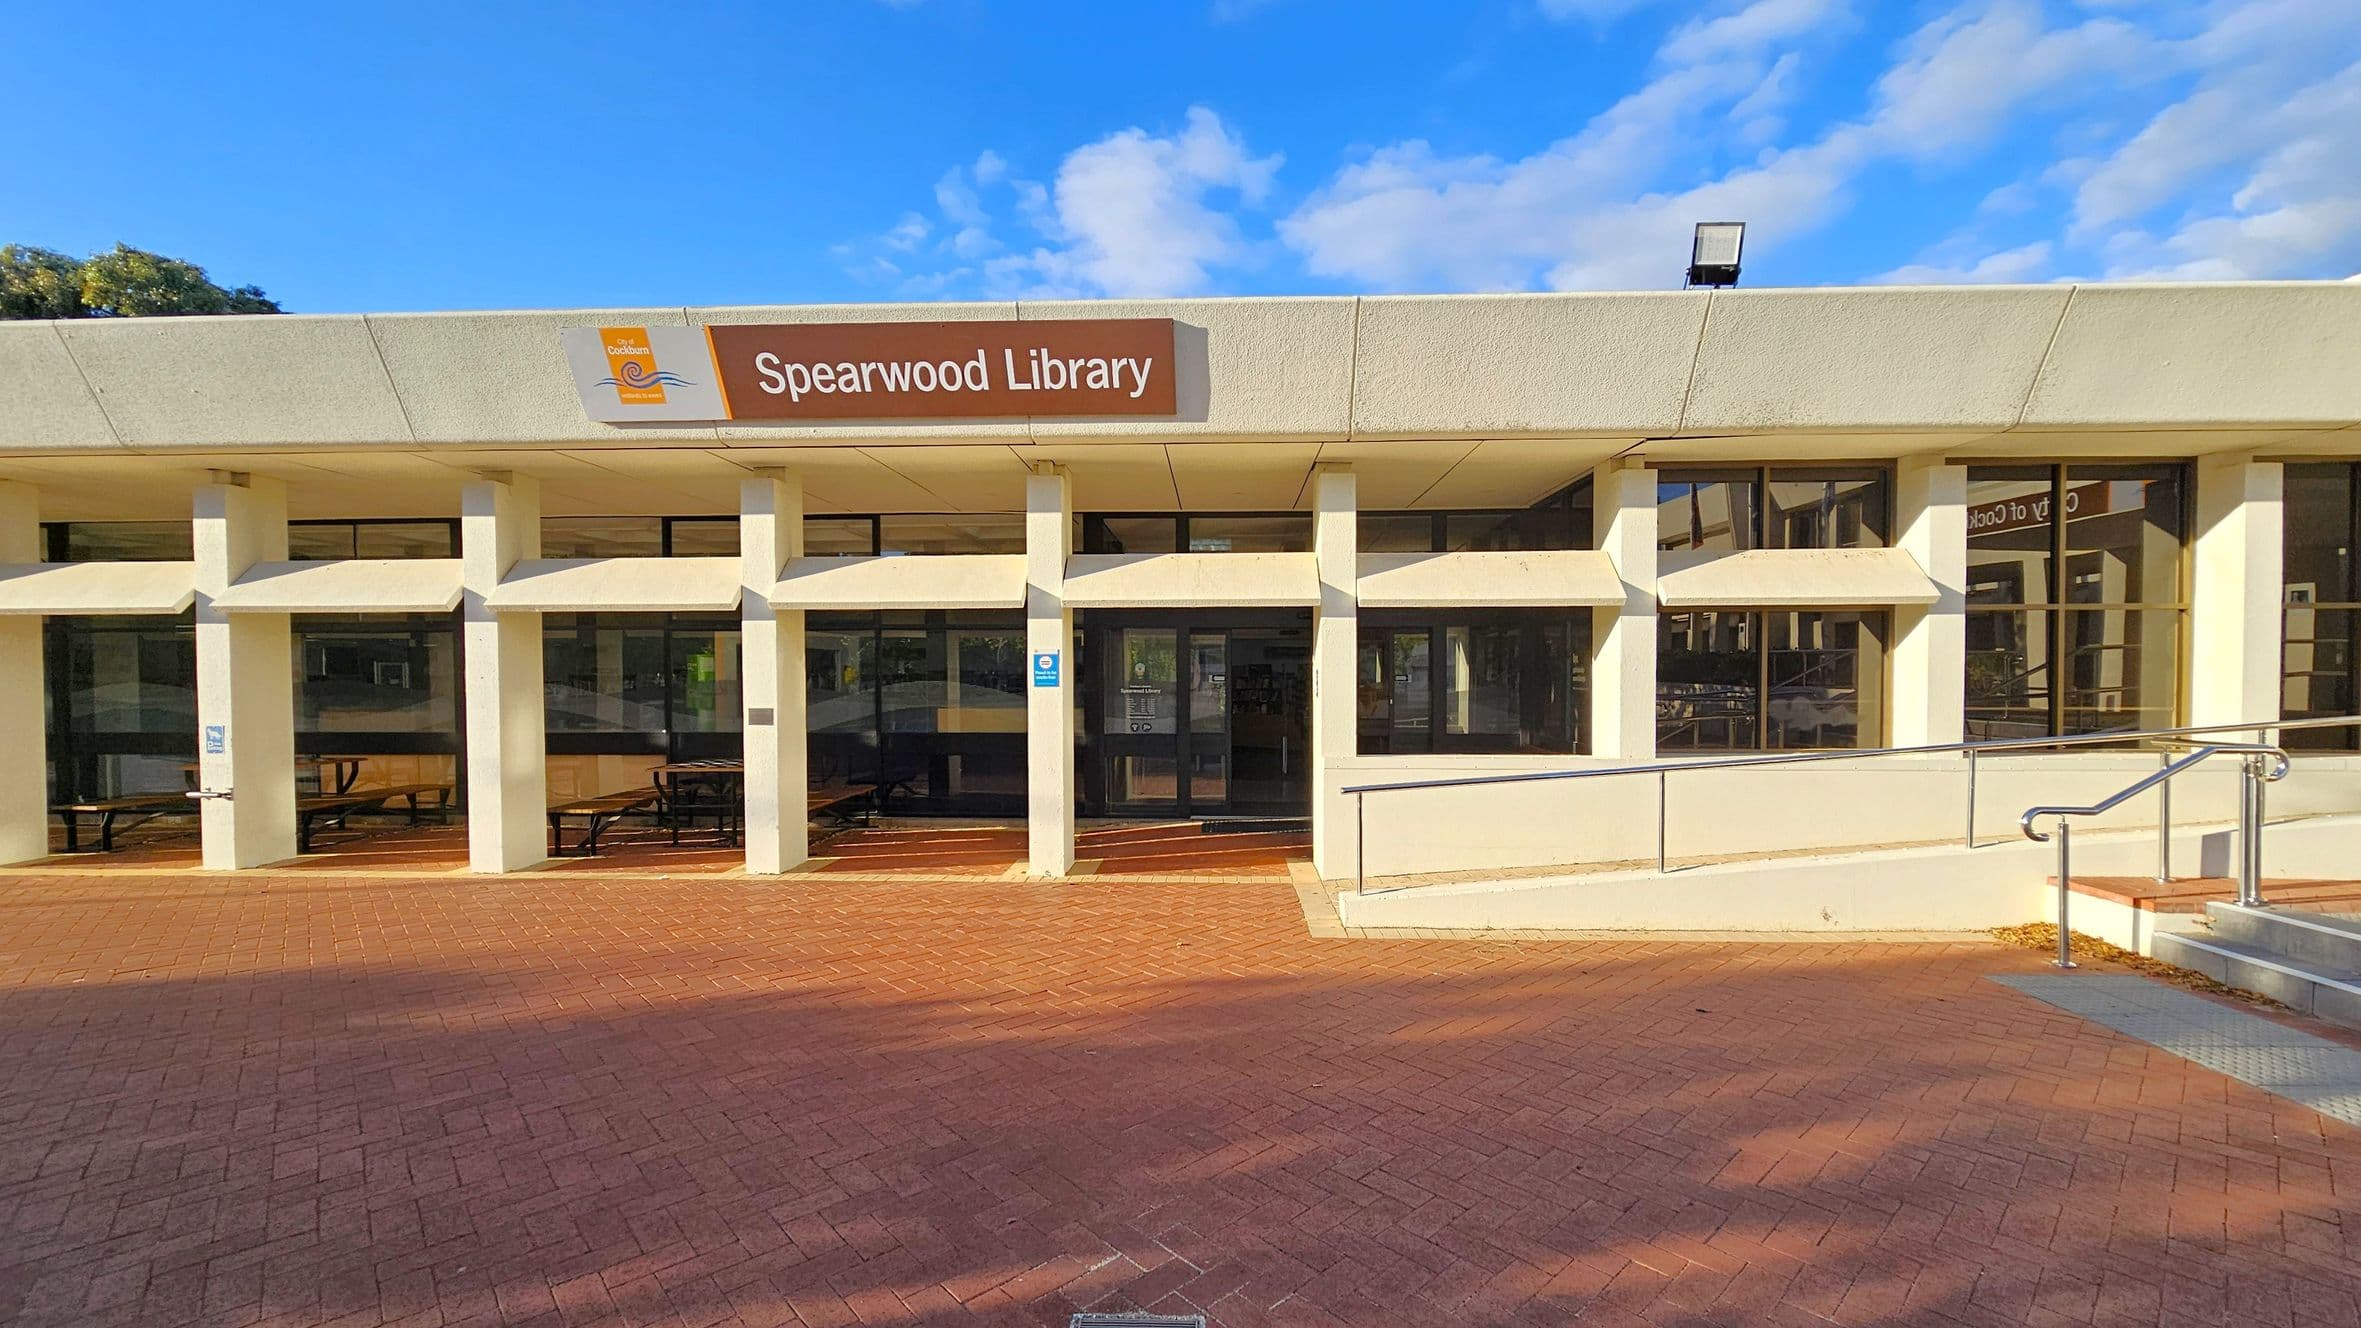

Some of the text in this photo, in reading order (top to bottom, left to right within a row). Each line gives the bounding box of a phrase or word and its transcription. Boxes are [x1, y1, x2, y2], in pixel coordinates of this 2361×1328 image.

[607, 346, 649, 355] Cockburn
[755, 347, 1153, 402] Spearwood Library
